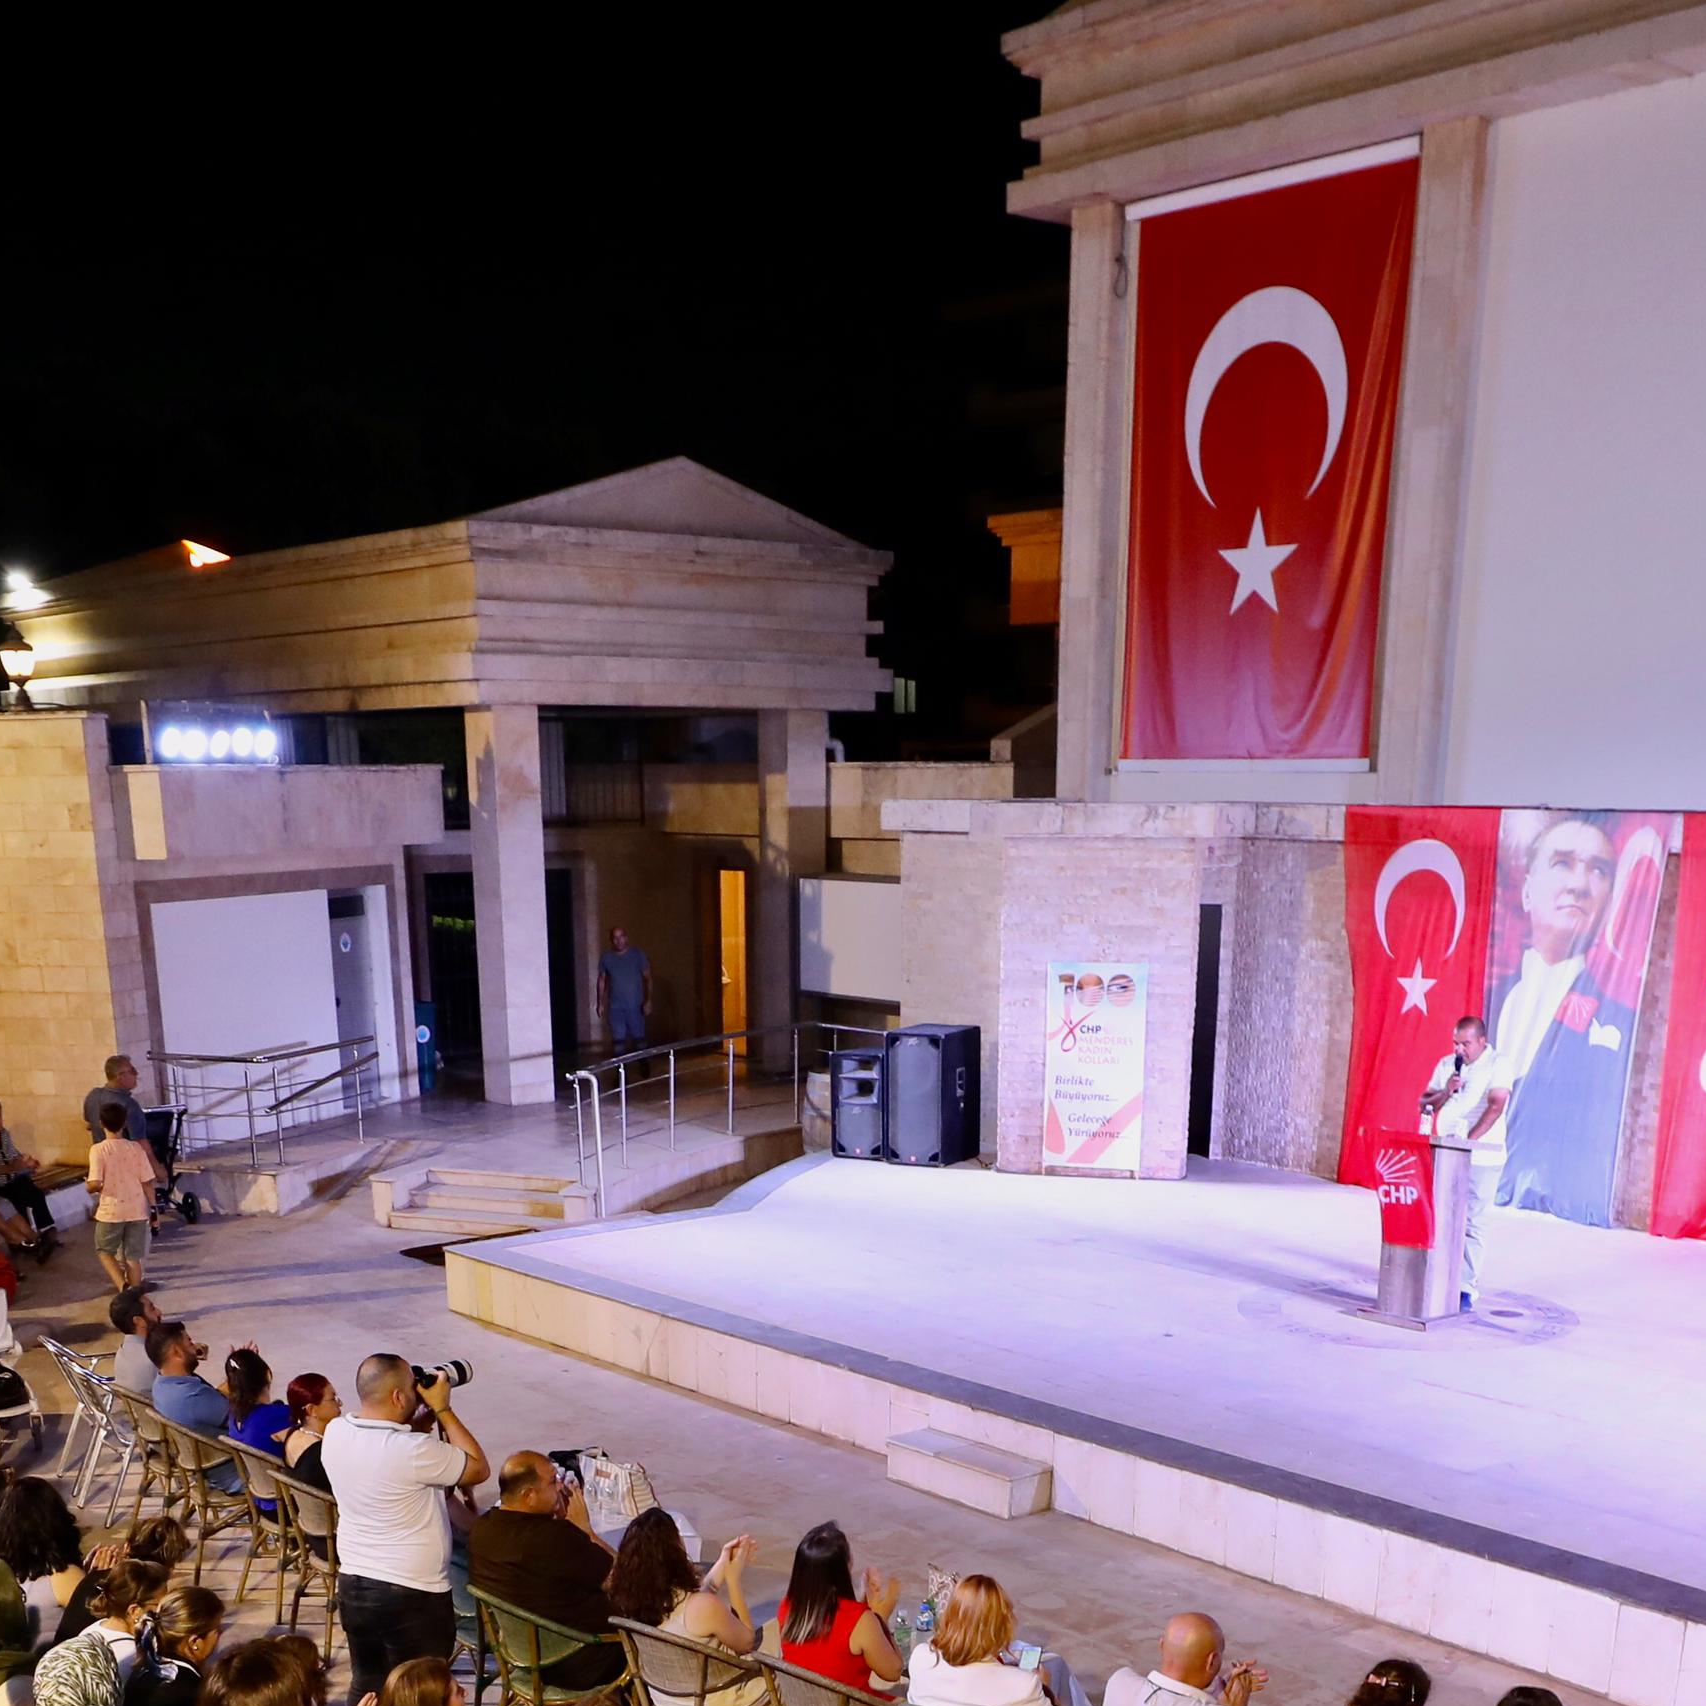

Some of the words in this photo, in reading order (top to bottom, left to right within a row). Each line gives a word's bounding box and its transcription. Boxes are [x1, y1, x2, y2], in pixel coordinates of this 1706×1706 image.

[1079, 1024, 1102, 1034] CHP
[1077, 1046, 1112, 1055] KADIN
[1054, 1075, 1095, 1087] Birlikte
[1377, 1184, 1419, 1206] CHP
